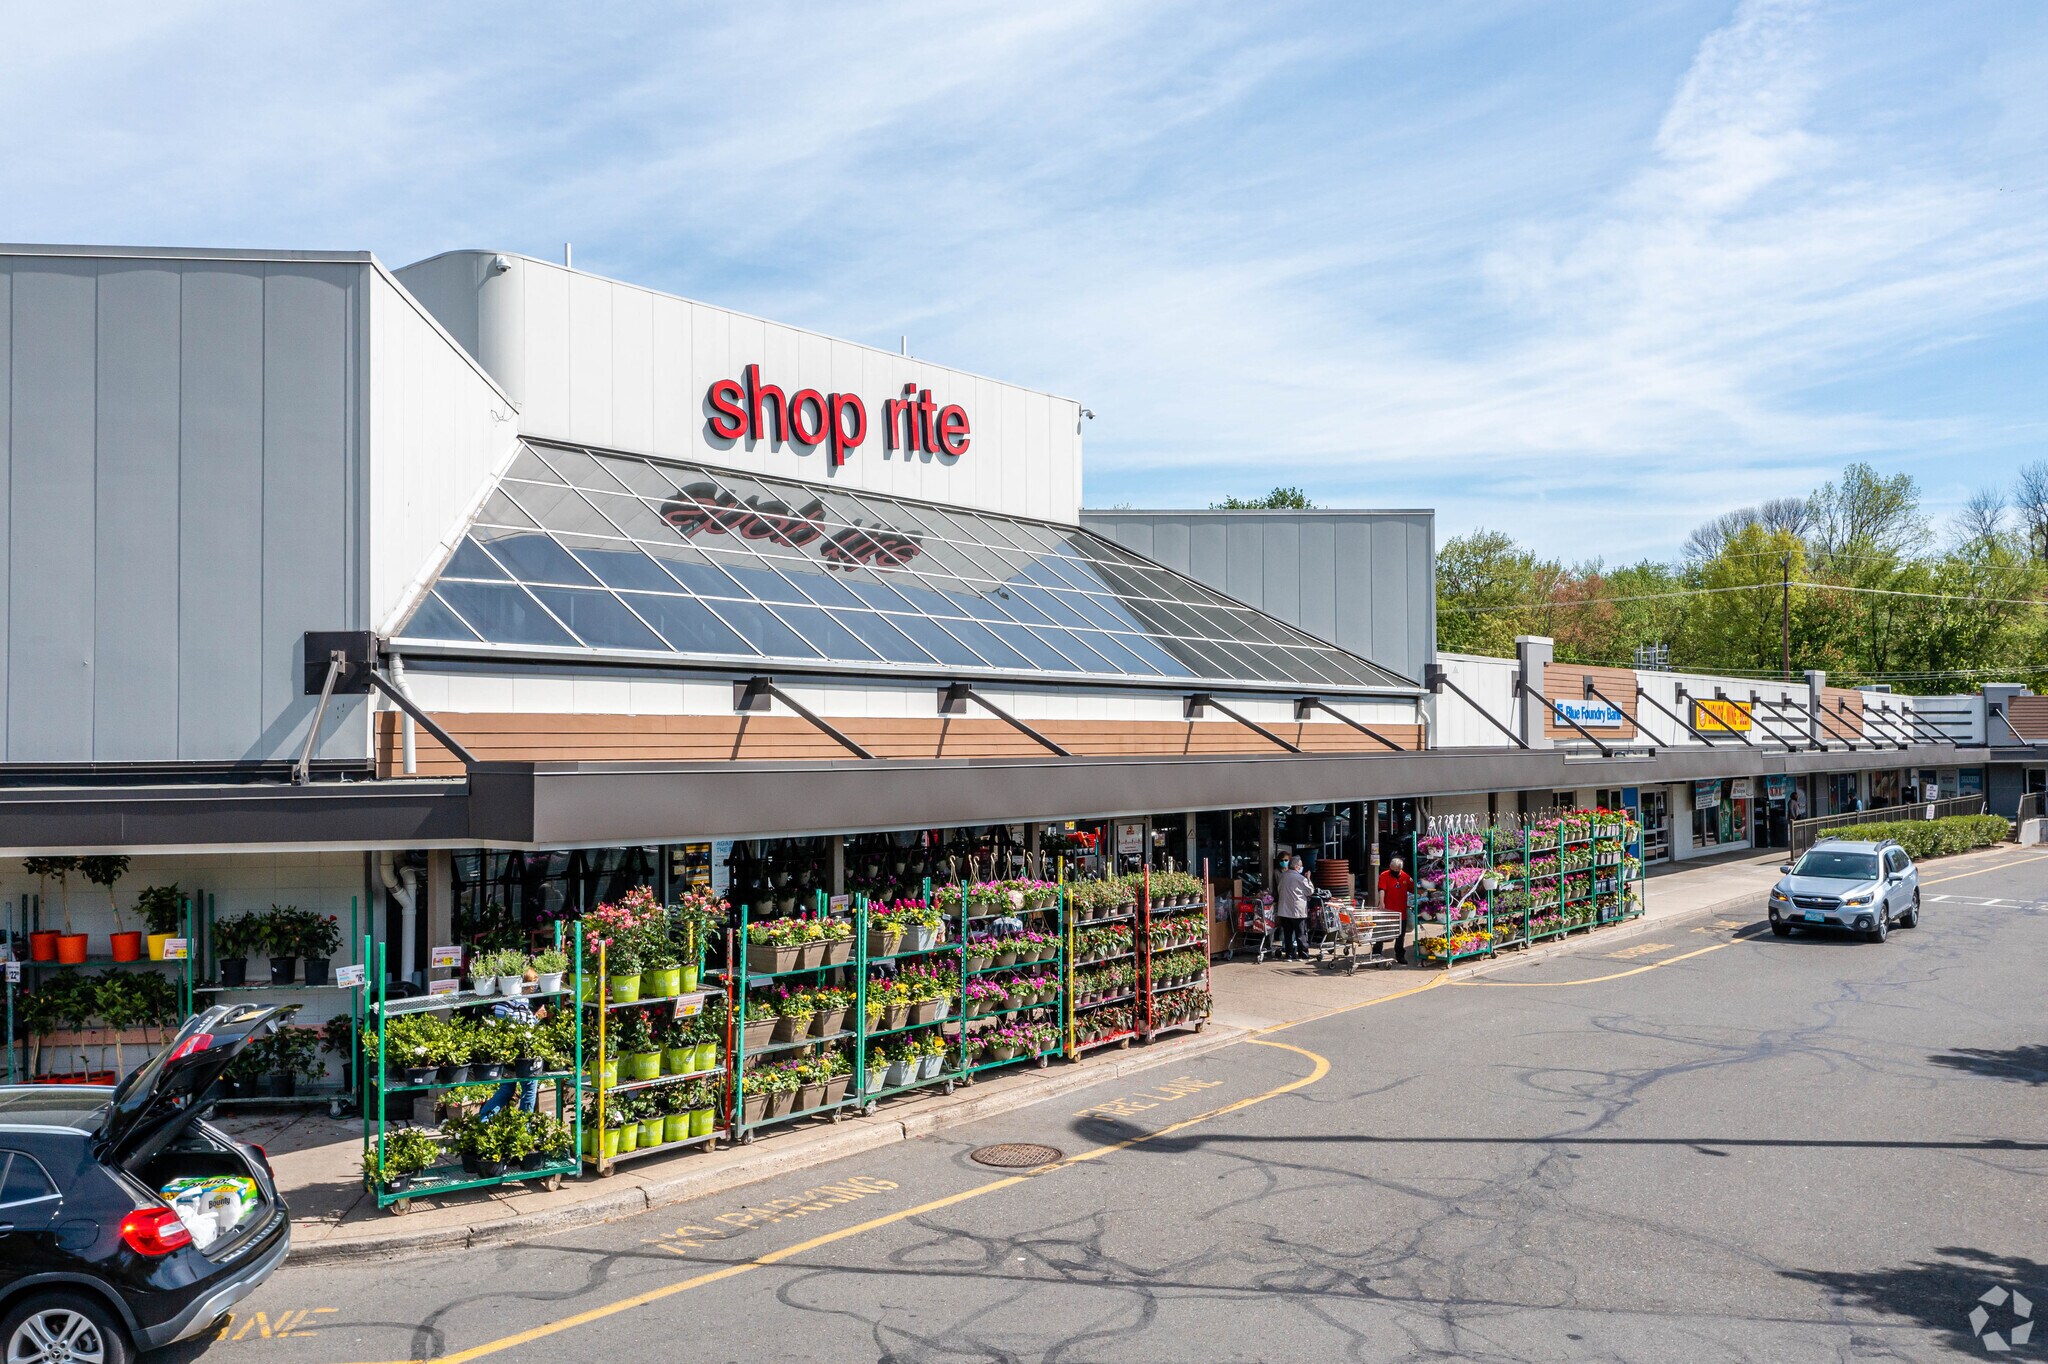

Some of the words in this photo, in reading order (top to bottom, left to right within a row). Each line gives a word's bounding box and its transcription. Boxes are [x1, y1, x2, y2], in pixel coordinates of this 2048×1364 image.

[707, 363, 867, 467] shop
[886, 382, 971, 457] rite
[1565, 705, 1581, 720] Blue
[1581, 706, 1606, 724] Foundry
[1132, 1076, 1224, 1101] LANE
[208, 1196, 231, 1210] Bounty
